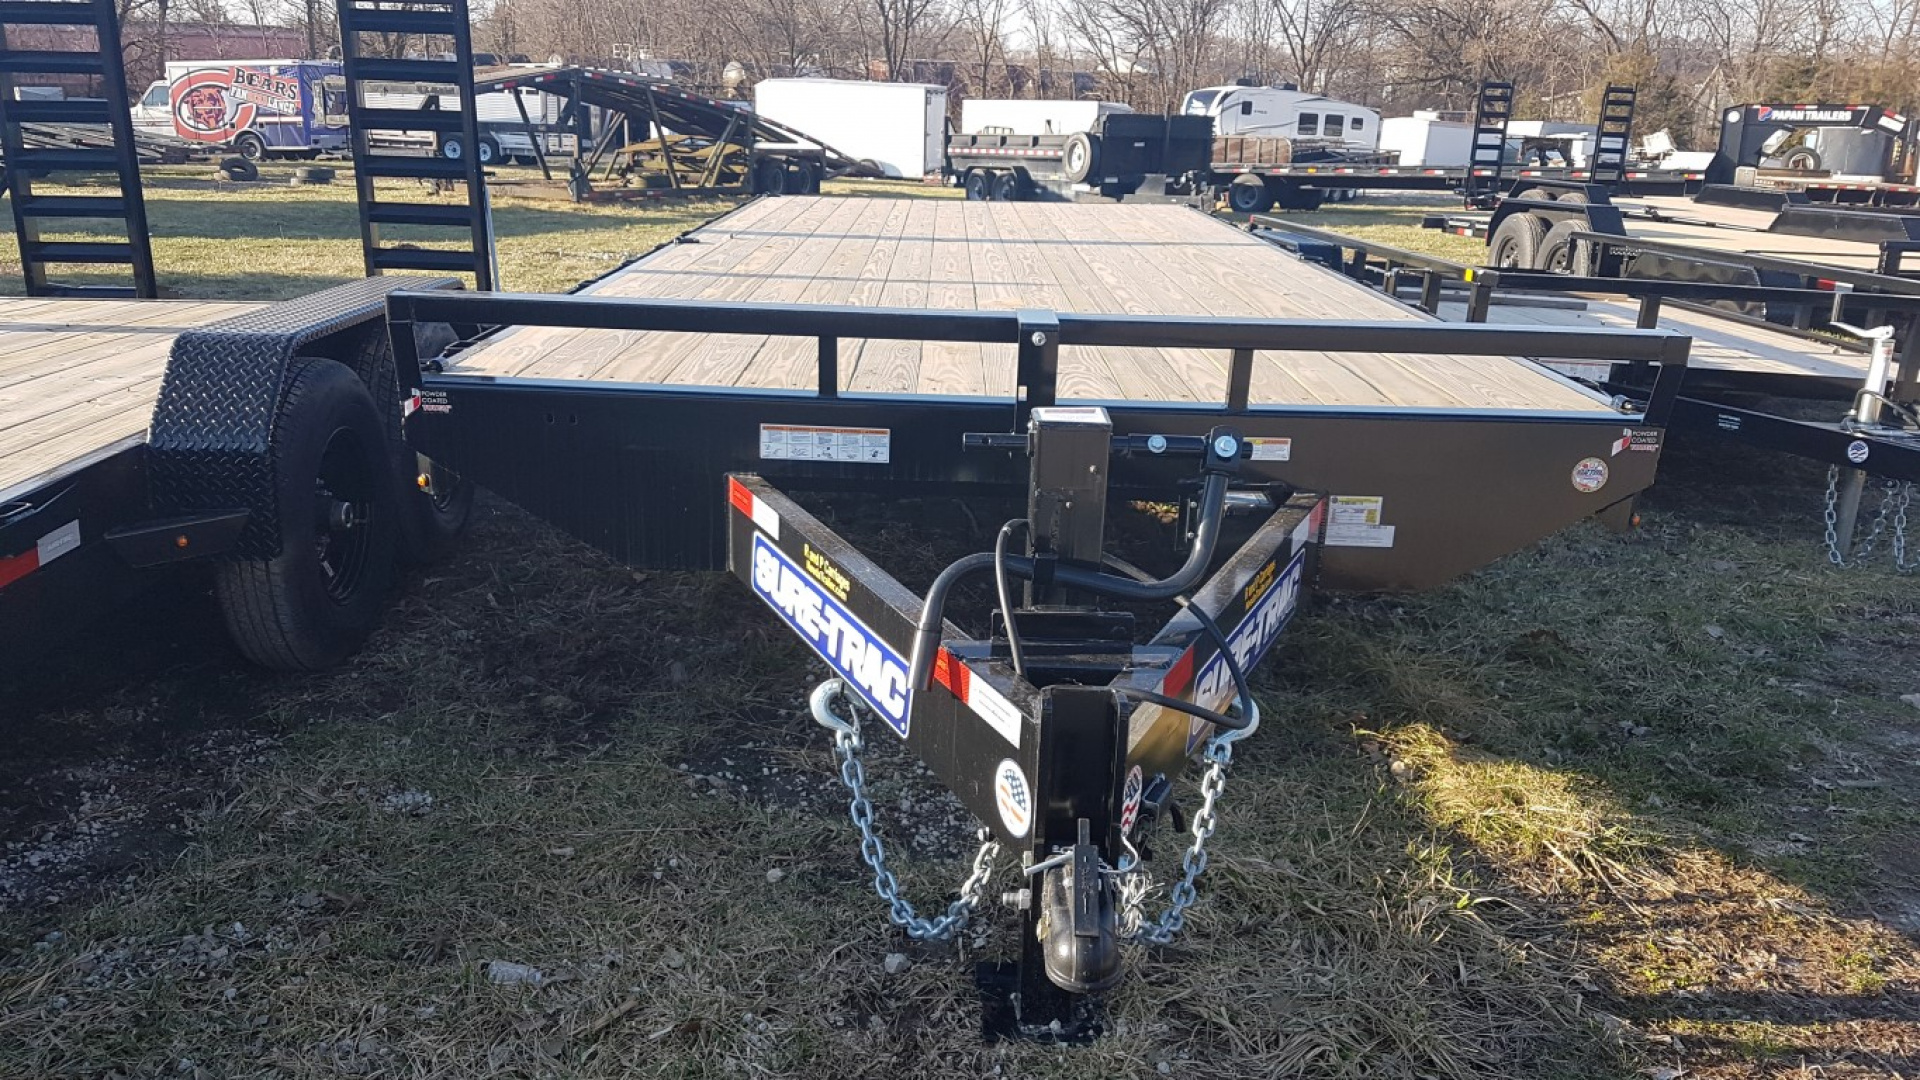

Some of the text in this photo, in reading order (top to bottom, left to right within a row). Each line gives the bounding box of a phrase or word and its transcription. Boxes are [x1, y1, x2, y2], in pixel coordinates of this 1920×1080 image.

[232, 66, 298, 101] BEARS
[1771, 109, 1852, 121] PAPAN TRAILERS
[755, 546, 907, 720] SURE-TRAC
